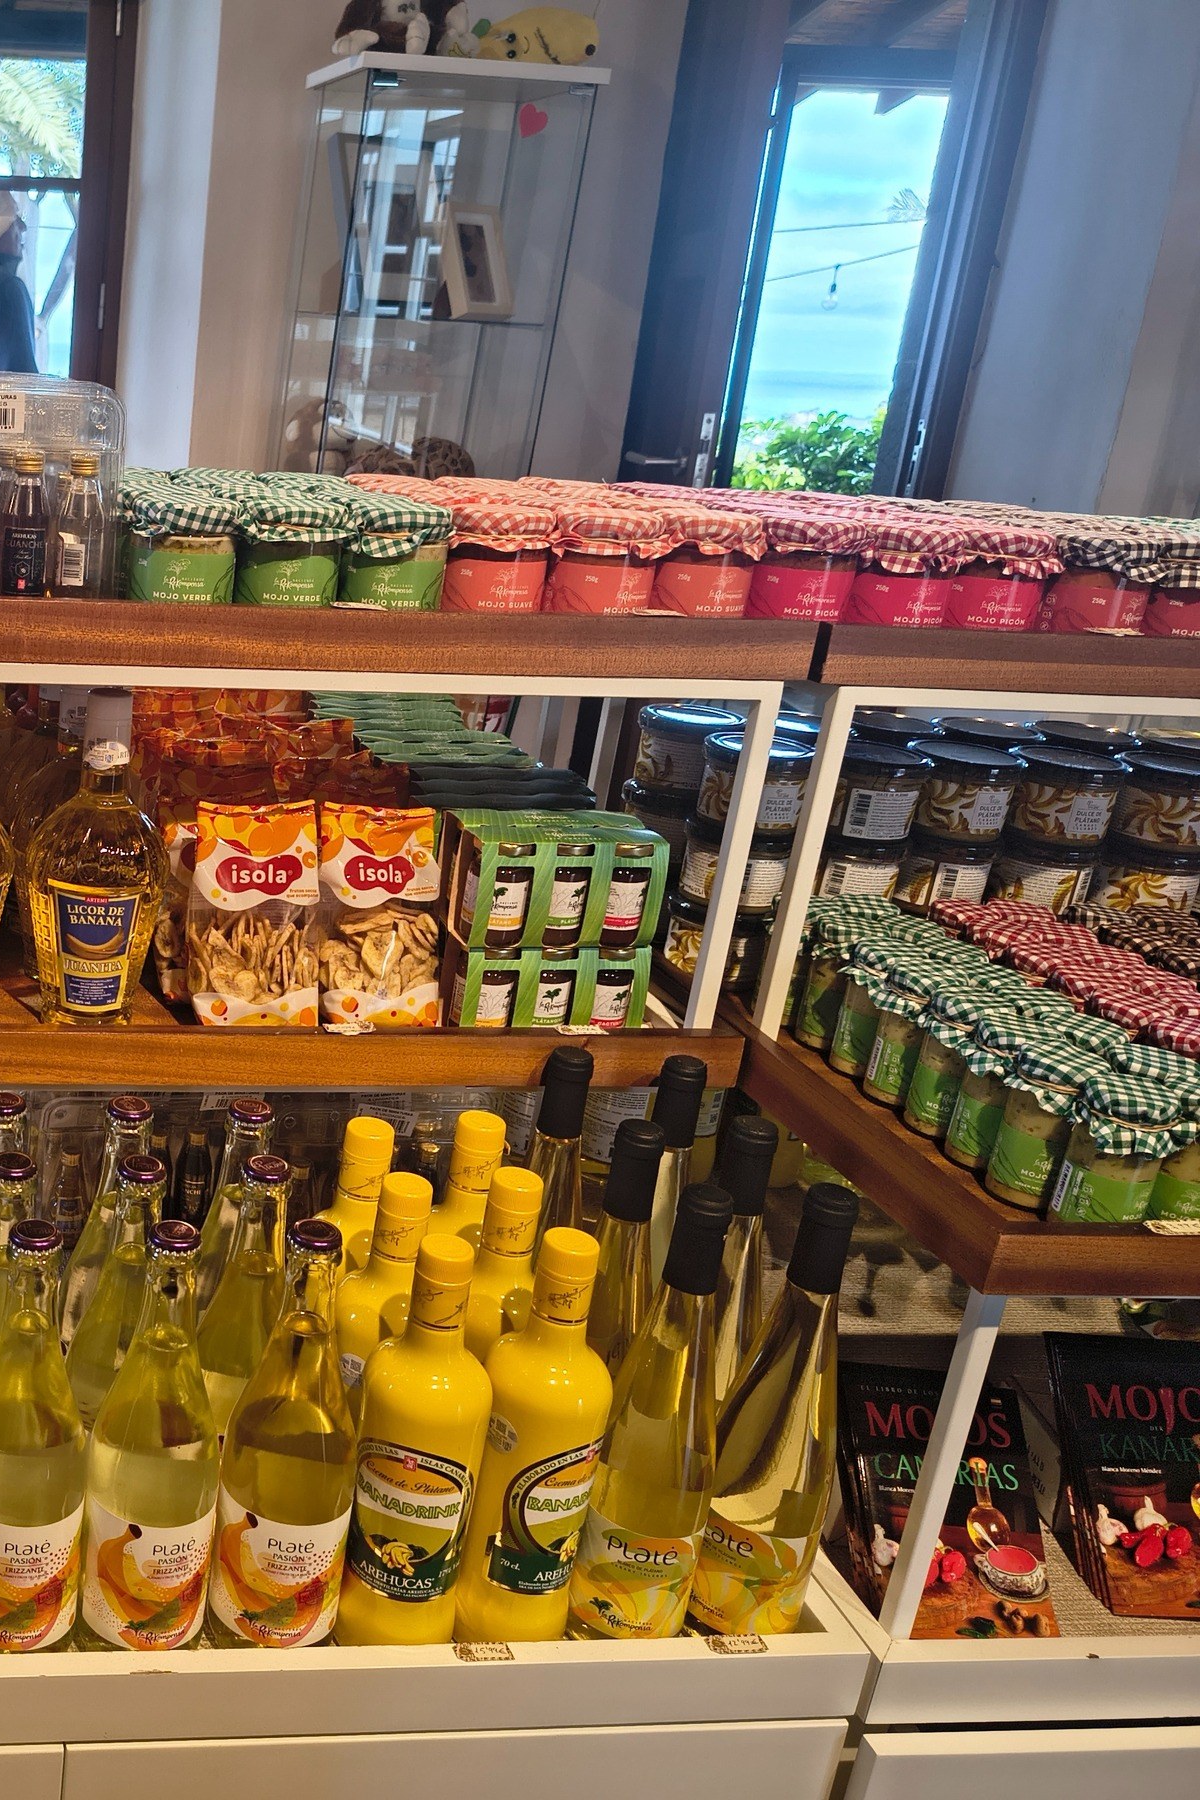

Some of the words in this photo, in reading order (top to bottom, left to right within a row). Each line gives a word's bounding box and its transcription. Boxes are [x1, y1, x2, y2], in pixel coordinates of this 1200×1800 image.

[585, 575, 598, 583] 250g
[677, 573, 691, 582] 250g
[766, 575, 779, 583] 250g
[875, 584, 889, 593] 250g
[153, 591, 179, 600] MOJO
[182, 593, 212, 601] VERDE
[263, 593, 289, 602] MOJO
[292, 594, 320, 602] VERDE
[1092, 597, 1106, 605] 250g
[361, 598, 387, 607] MOJO
[478, 600, 505, 608] MOJO
[603, 606, 629, 614] MOJO
[695, 605, 722, 613] MOJO
[783, 607, 812, 616] MOJO
[815, 608, 839, 617] PICÓN
[893, 616, 920, 624] MOJO
[967, 615, 996, 624] MOJO
[999, 616, 1026, 625] PICÓN
[231, 864, 287, 884] isola
[358, 862, 402, 883] isola
[67, 904, 105, 916] LICOR
[108, 906, 125, 916] DE
[70, 915, 122, 926] BANANA
[63, 959, 123, 972] JUANITA
[926, 1101, 950, 1112] MOJO
[1020, 1168, 1048, 1180] MOJO
[864, 1401, 1011, 1448] MOOS
[385, 1447, 399, 1456] LAS
[420, 1457, 444, 1470] ISLAS
[366, 1460, 394, 1484] Crema
[394, 1479, 409, 1489] de
[517, 1462, 557, 1491] ELABORADO
[569, 1452, 584, 1461] LAS
[1120, 1466, 1140, 1474] Moreno
[1141, 1466, 1162, 1475] Méndez
[544, 1477, 577, 1488] Crema
[358, 1471, 461, 1519] BANADRINK
[10, 1556, 42, 1564] PASIÓN
[157, 1554, 188, 1565] PASIÓN
[272, 1553, 305, 1562] PASIÓN
[152, 1564, 190, 1575] FRIZZANTE
[267, 1561, 308, 1572] FRIZZANTE
[500, 1558, 510, 1567] 70
[510, 1563, 521, 1571] cl.
[5, 1566, 45, 1575] FRIZZANTE
[360, 1560, 432, 1589] AREHUCAS
